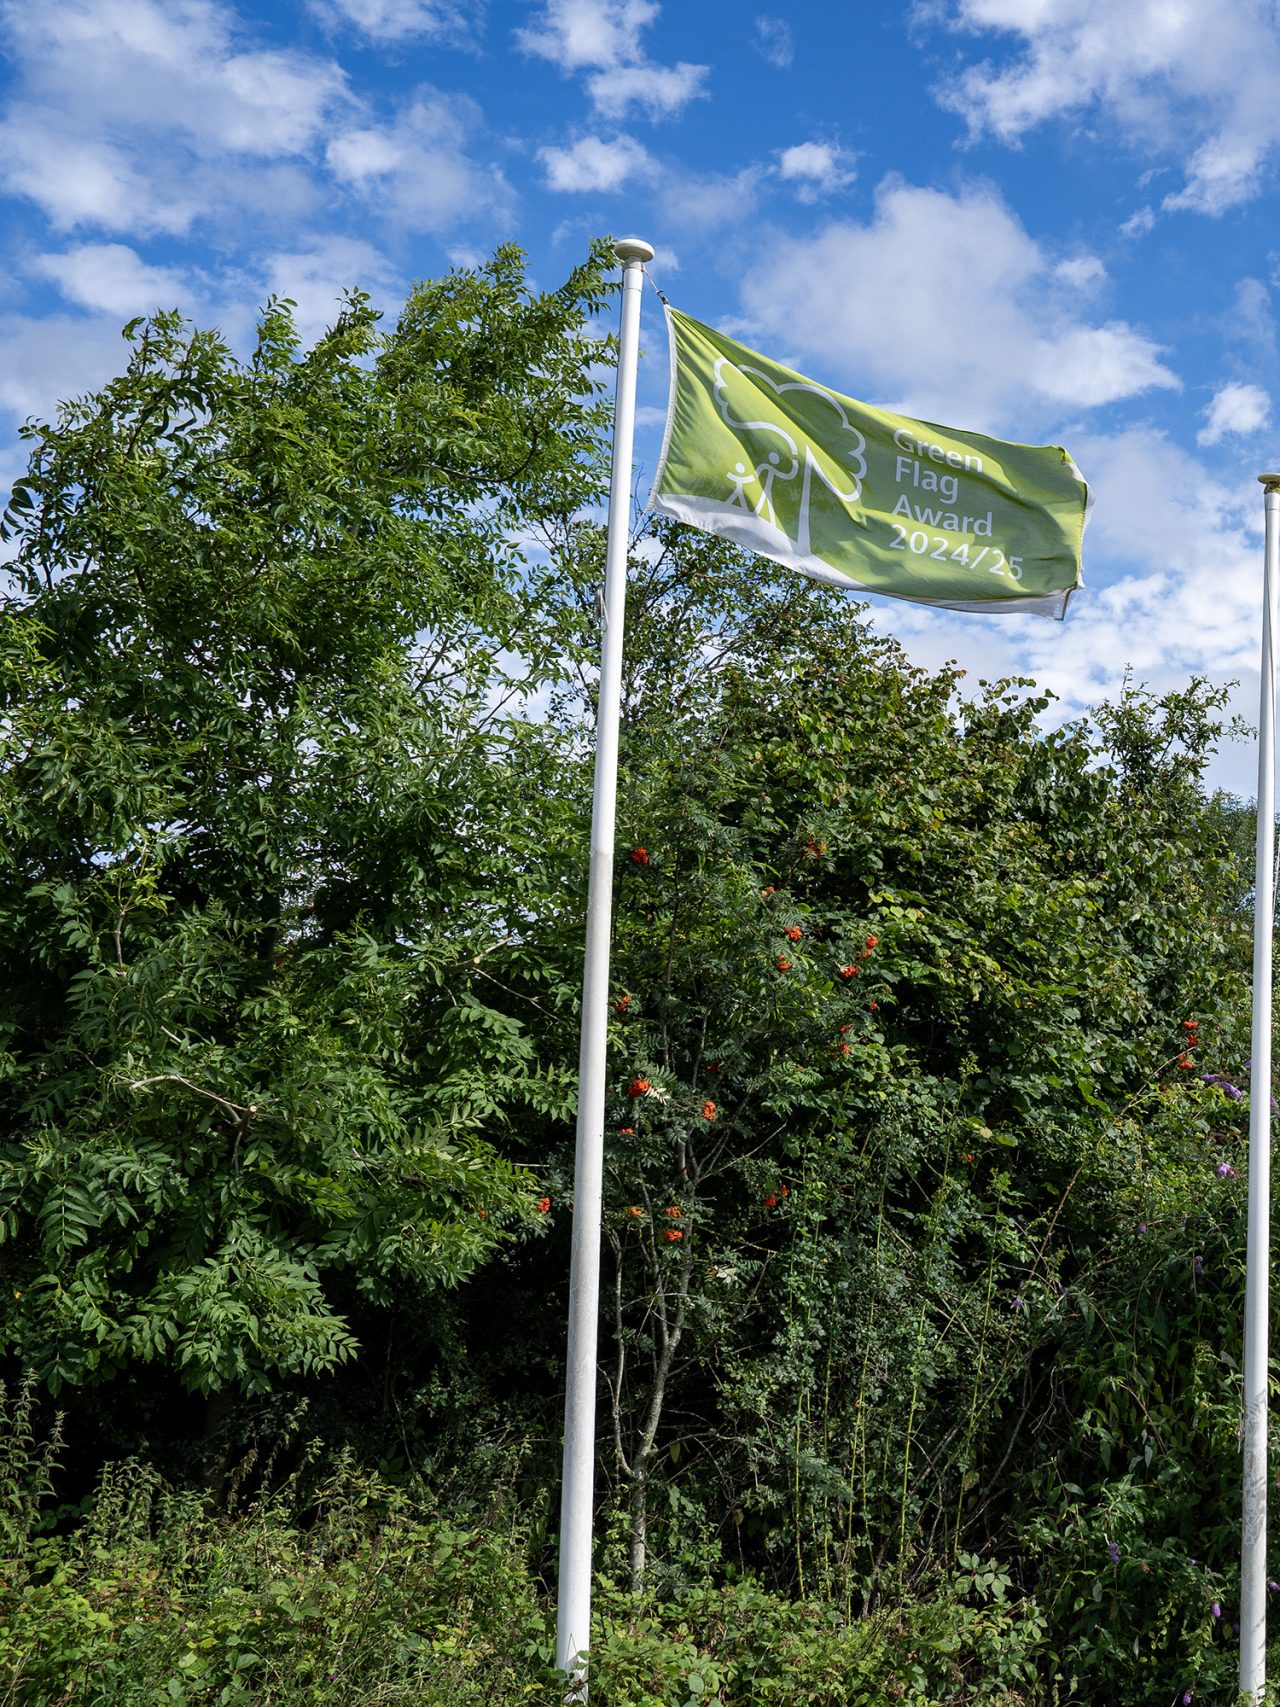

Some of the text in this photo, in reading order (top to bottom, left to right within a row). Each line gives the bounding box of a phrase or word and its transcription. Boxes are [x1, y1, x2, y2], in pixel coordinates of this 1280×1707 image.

[893, 429, 983, 473] Green
[895, 455, 958, 504] Flag
[892, 494, 993, 537] Award
[889, 524, 1024, 581] 2024/25
